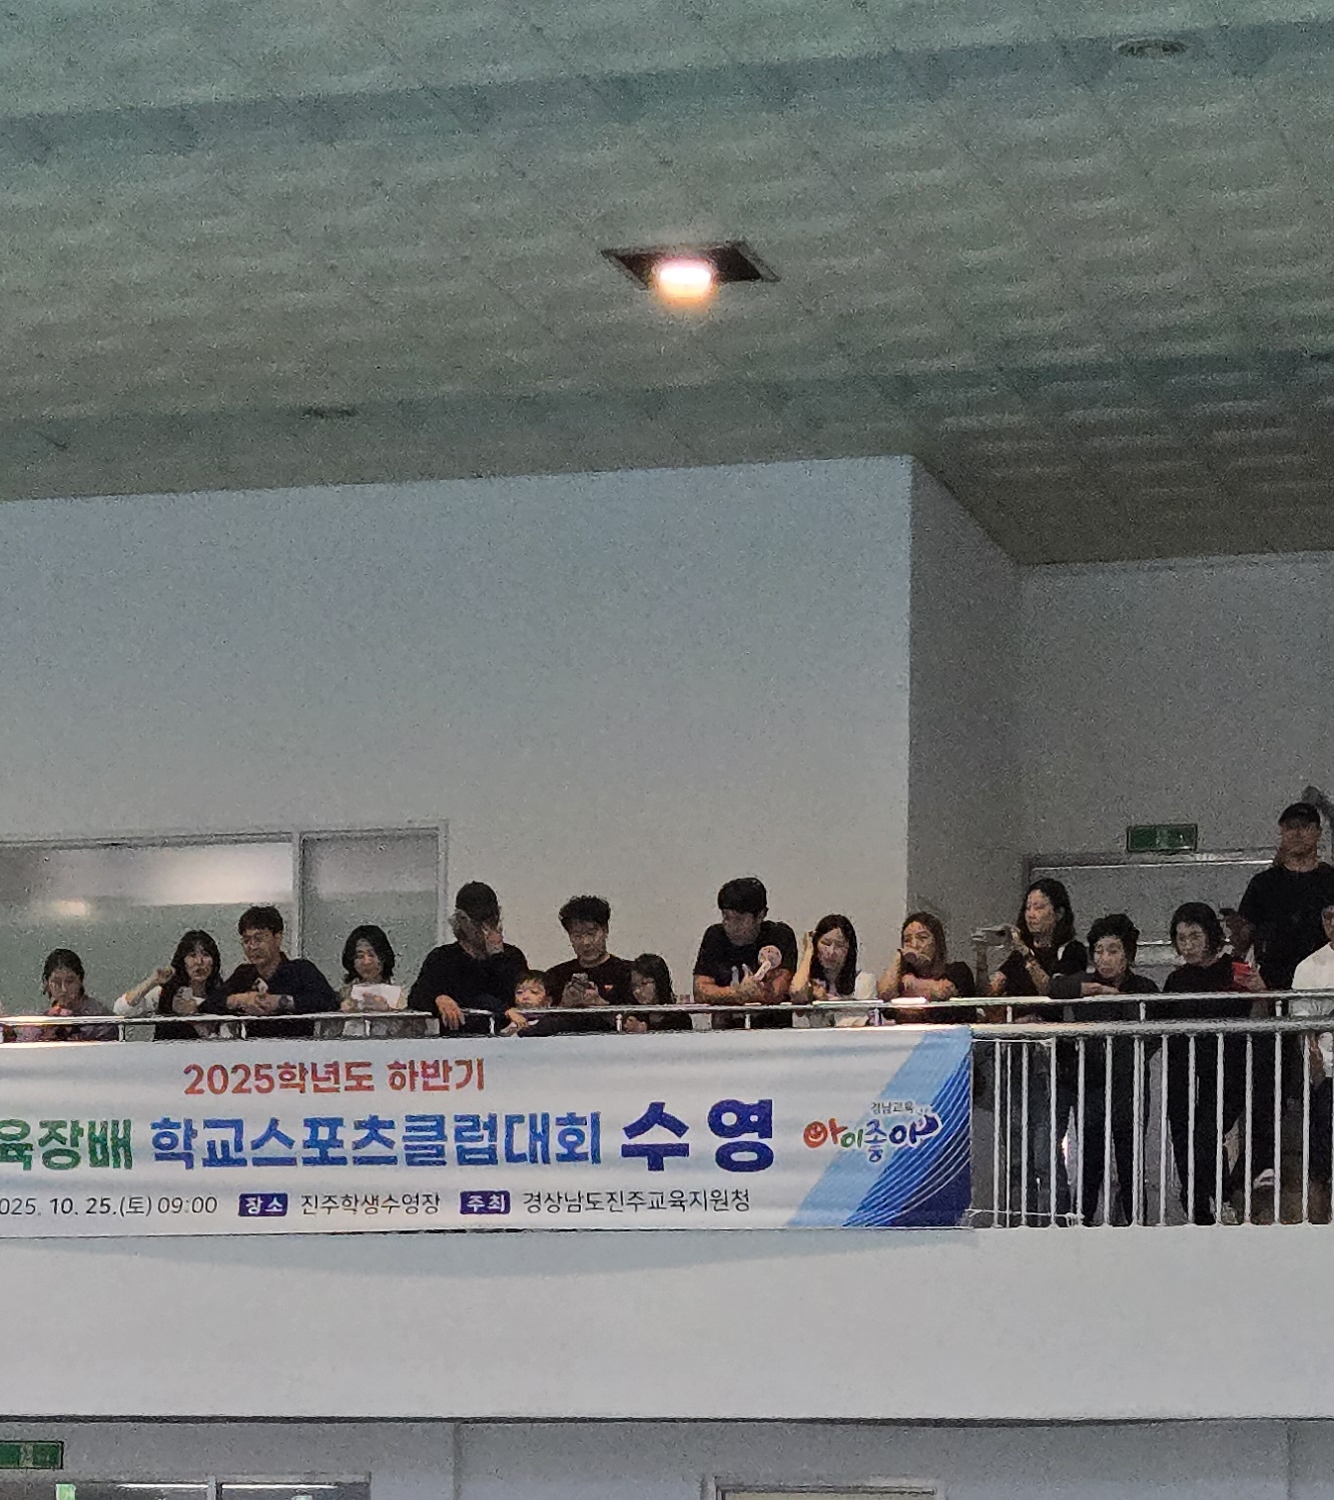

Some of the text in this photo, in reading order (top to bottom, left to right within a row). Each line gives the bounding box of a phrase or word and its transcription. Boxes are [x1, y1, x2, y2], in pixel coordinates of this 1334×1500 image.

[183, 1058, 485, 1095] 2025학년도 하반기
[871, 1102, 915, 1115] 경남교육
[150, 1111, 602, 1170] 학교스포츠클럽대회
[50, 1197, 79, 1216] 10.
[158, 1196, 218, 1214] 09:00
[245, 1196, 284, 1214] 장소
[300, 1192, 441, 1216] 진주학생수영장
[466, 1193, 506, 1212] 주최
[522, 1189, 750, 1214] 경상남도진주교육지원청
